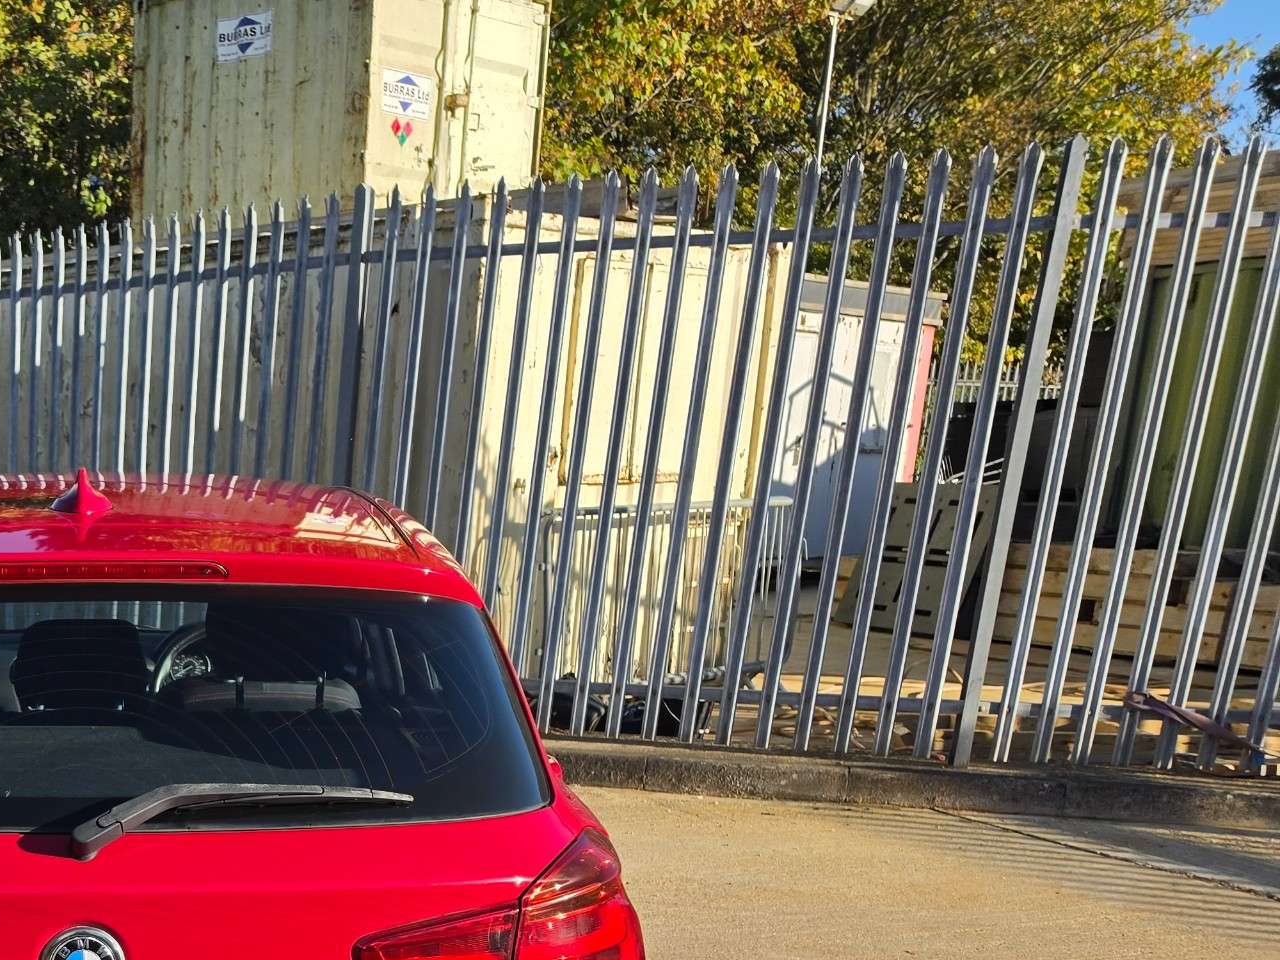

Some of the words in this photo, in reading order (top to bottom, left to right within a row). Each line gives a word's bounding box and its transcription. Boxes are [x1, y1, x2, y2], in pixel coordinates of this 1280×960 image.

[383, 82, 415, 98] BURRAS
[417, 89, 430, 101] Ltd
[58, 938, 112, 959] BMW
